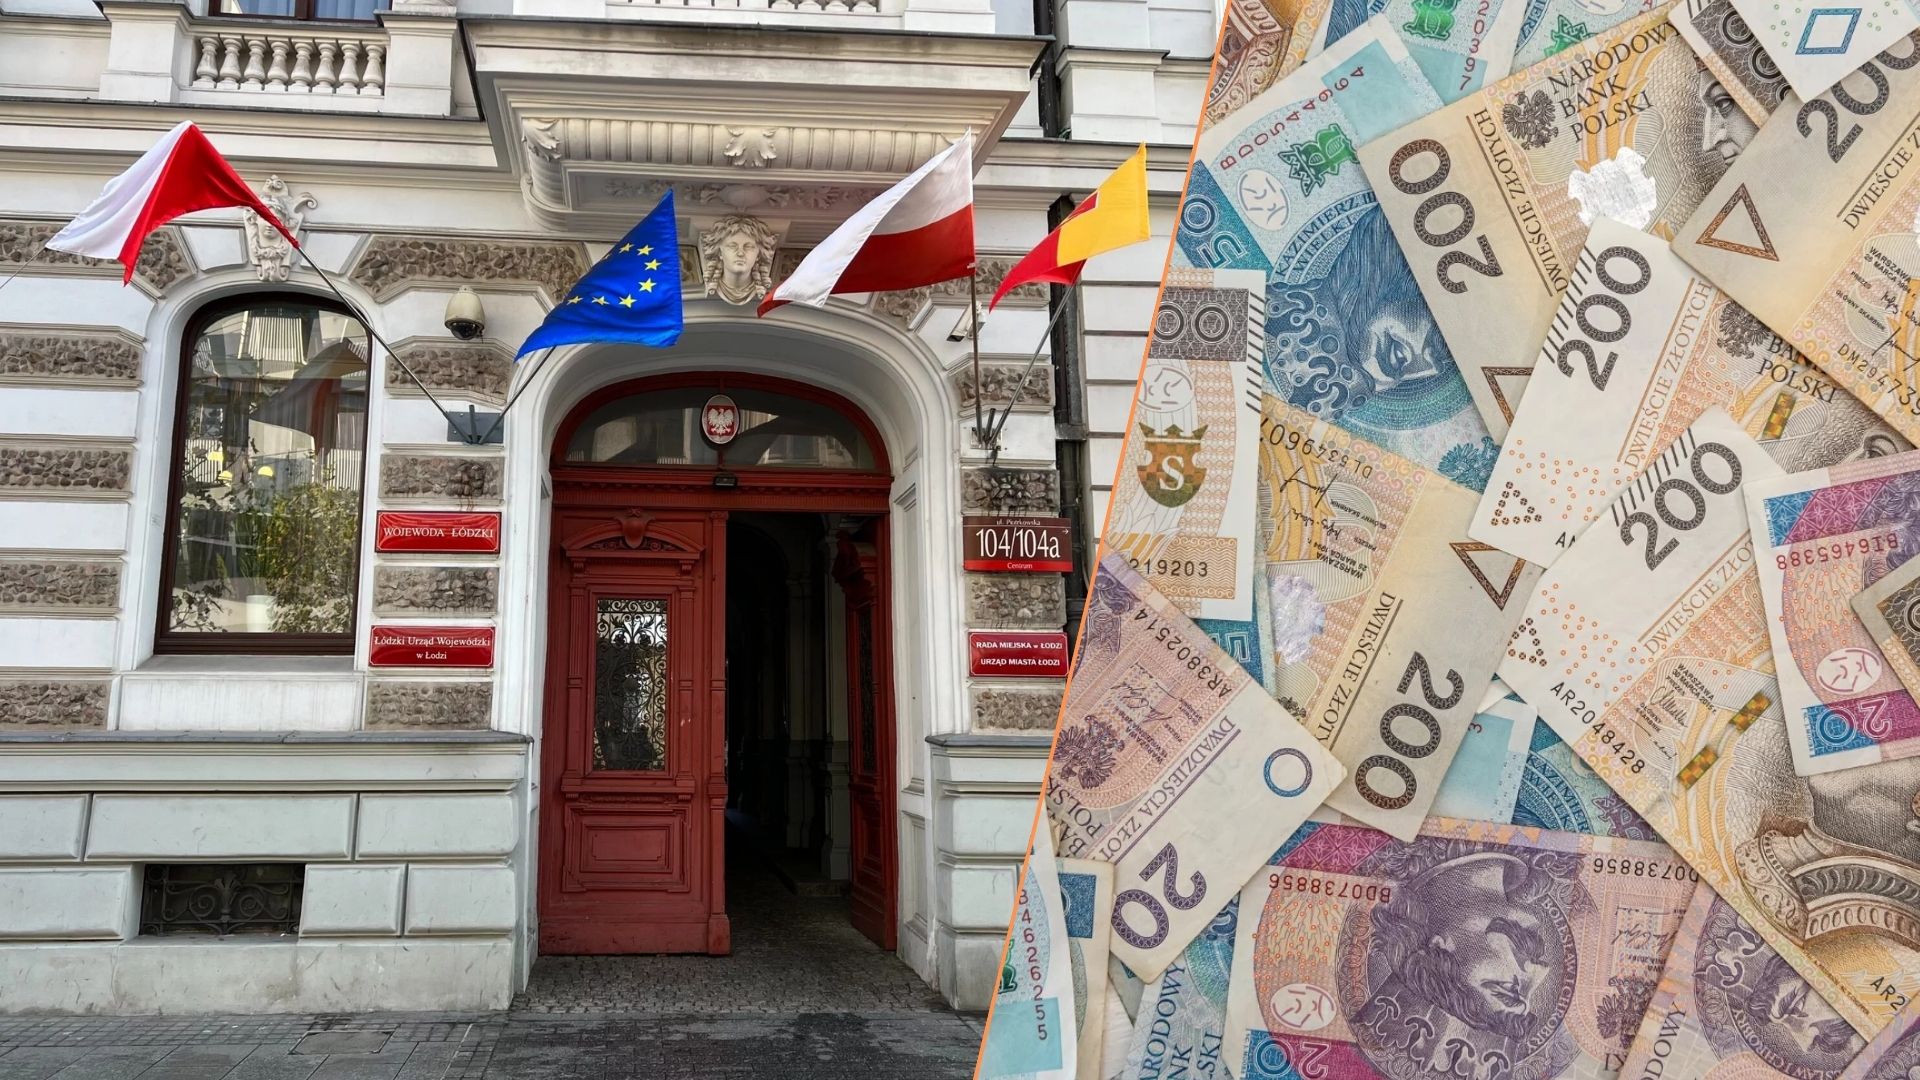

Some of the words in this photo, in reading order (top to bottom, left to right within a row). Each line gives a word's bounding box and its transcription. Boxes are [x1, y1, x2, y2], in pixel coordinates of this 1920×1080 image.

[1547, 21, 1681, 95] NARODOWY
[1559, 74, 1628, 119] BANK
[1571, 89, 1654, 143] POLSKI
[1473, 107, 1530, 202] ZŁOTYCH
[1842, 146, 1914, 231] DWIEŚCIE
[1388, 138, 1504, 295] 200
[1513, 199, 1569, 294] DWIEŚCIE
[1868, 246, 1912, 284] WARSZAWA
[1557, 245, 1652, 392] 200
[1623, 376, 1673, 470] DWIEŚCIE
[1662, 280, 1714, 377] ZŁOTYCH
[1768, 335, 1827, 375] BA
[1756, 358, 1838, 404] POLSKI
[1159, 456, 1185, 491] S
[1620, 441, 1743, 571] 200
[383, 527, 445, 537] WOJEWODA
[451, 527, 494, 538] ŁÓDZKI
[976, 527, 1061, 559] 104/104a
[1776, 533, 1898, 571] BI6465388
[1316, 552, 1364, 580] WARSZAWA
[1341, 590, 1397, 684] DWIEŚCIE
[1642, 578, 1720, 657] DWIEŚCIE
[374, 636, 405, 646] Łódzki
[407, 636, 434, 647] Urząd
[436, 636, 491, 647] Wojewódzki
[425, 652, 447, 660] Łodzi
[976, 641, 998, 649] RADA
[999, 641, 1032, 649] MIEJSKA
[980, 658, 1006, 667] URZĄD
[1009, 658, 1037, 666] MIASTA
[1133, 607, 1233, 698] AR3802514
[1677, 663, 1715, 701] WARSZAWA
[1680, 676, 1701, 699] MARCA
[1354, 651, 1465, 810] 200
[1550, 681, 1645, 775] AR2048428
[1138, 715, 1236, 818] DWADZIEŚCIA
[1092, 815, 1142, 862] ZŁOT
[1111, 841, 1207, 949] 20
[1268, 873, 1393, 904] BD0738856
[1869, 976, 1906, 1011] AR2
[1197, 1032, 1223, 1080] SKI
